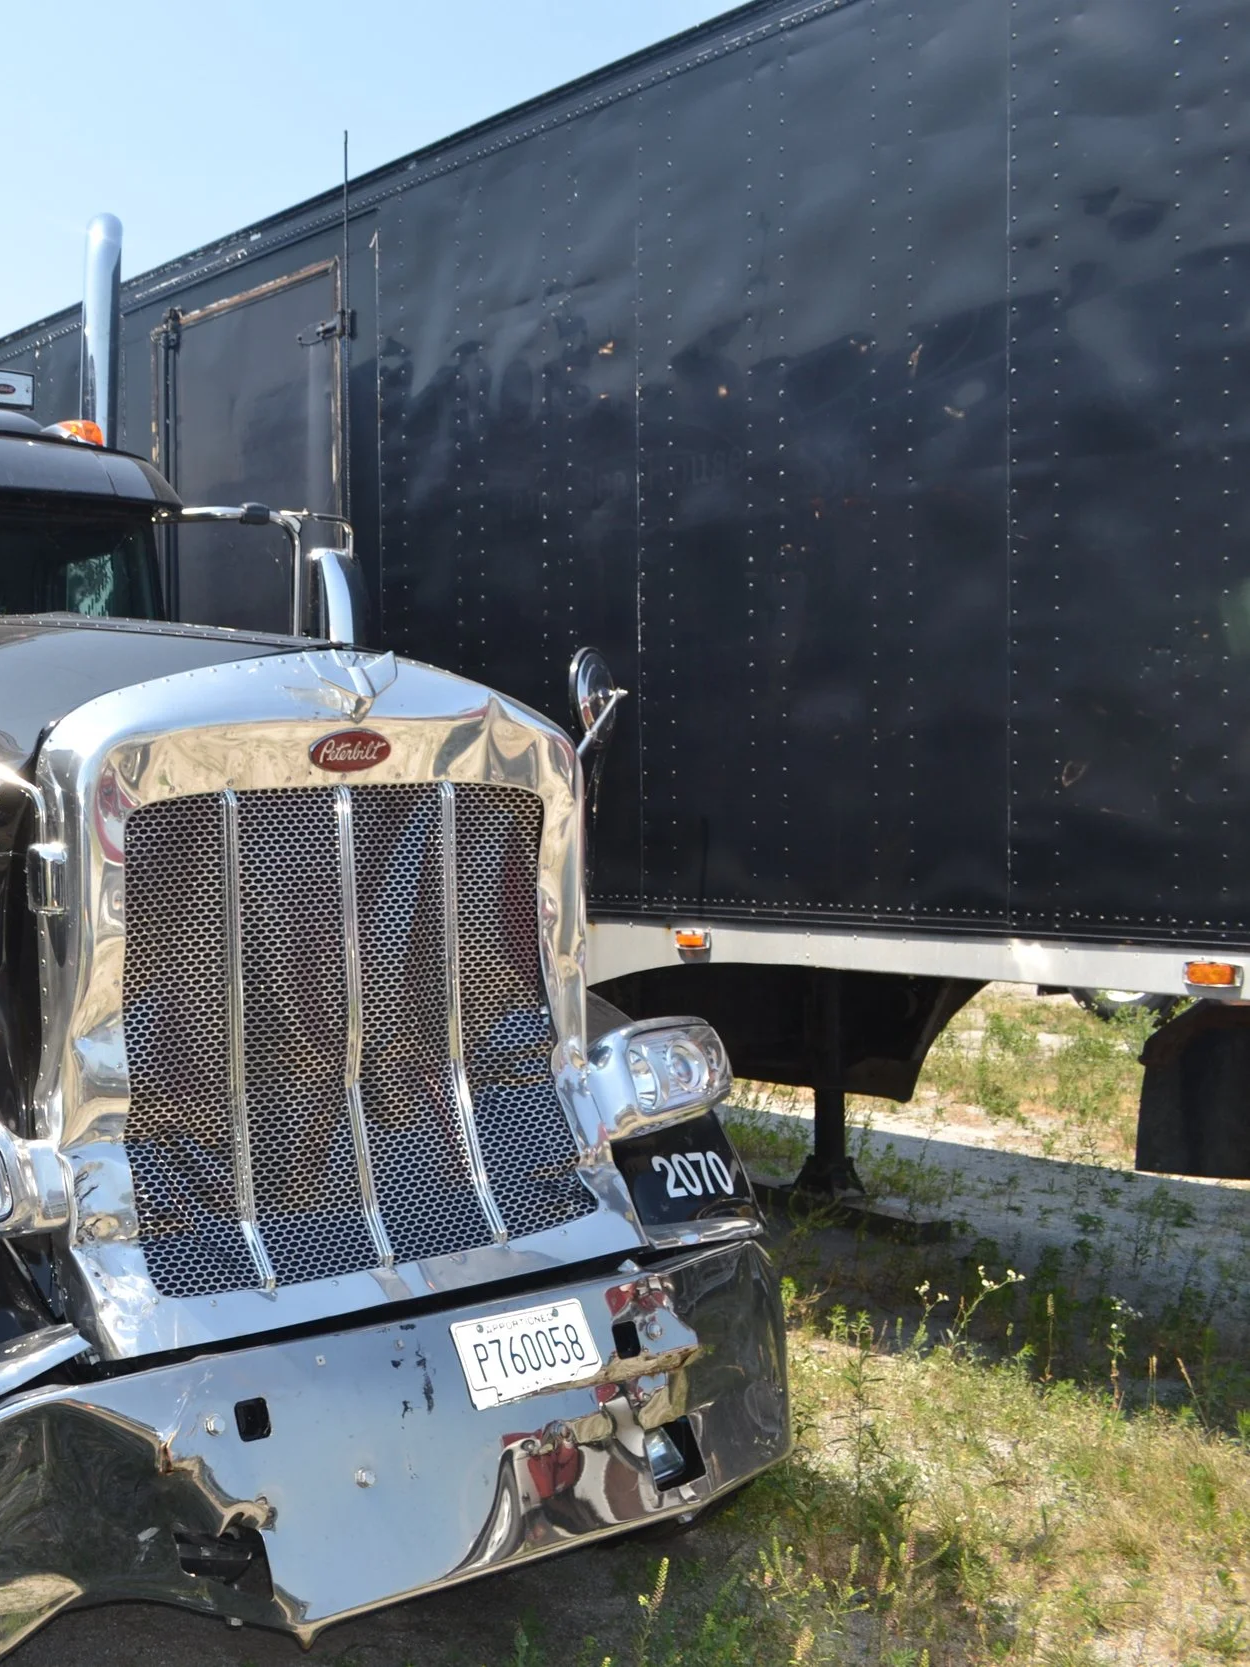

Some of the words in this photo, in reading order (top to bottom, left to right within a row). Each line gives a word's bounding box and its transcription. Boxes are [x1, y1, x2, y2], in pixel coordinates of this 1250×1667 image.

[319, 739, 387, 764] Peterbilt
[651, 1150, 735, 1198] 2070
[473, 1323, 586, 1383] P760058
